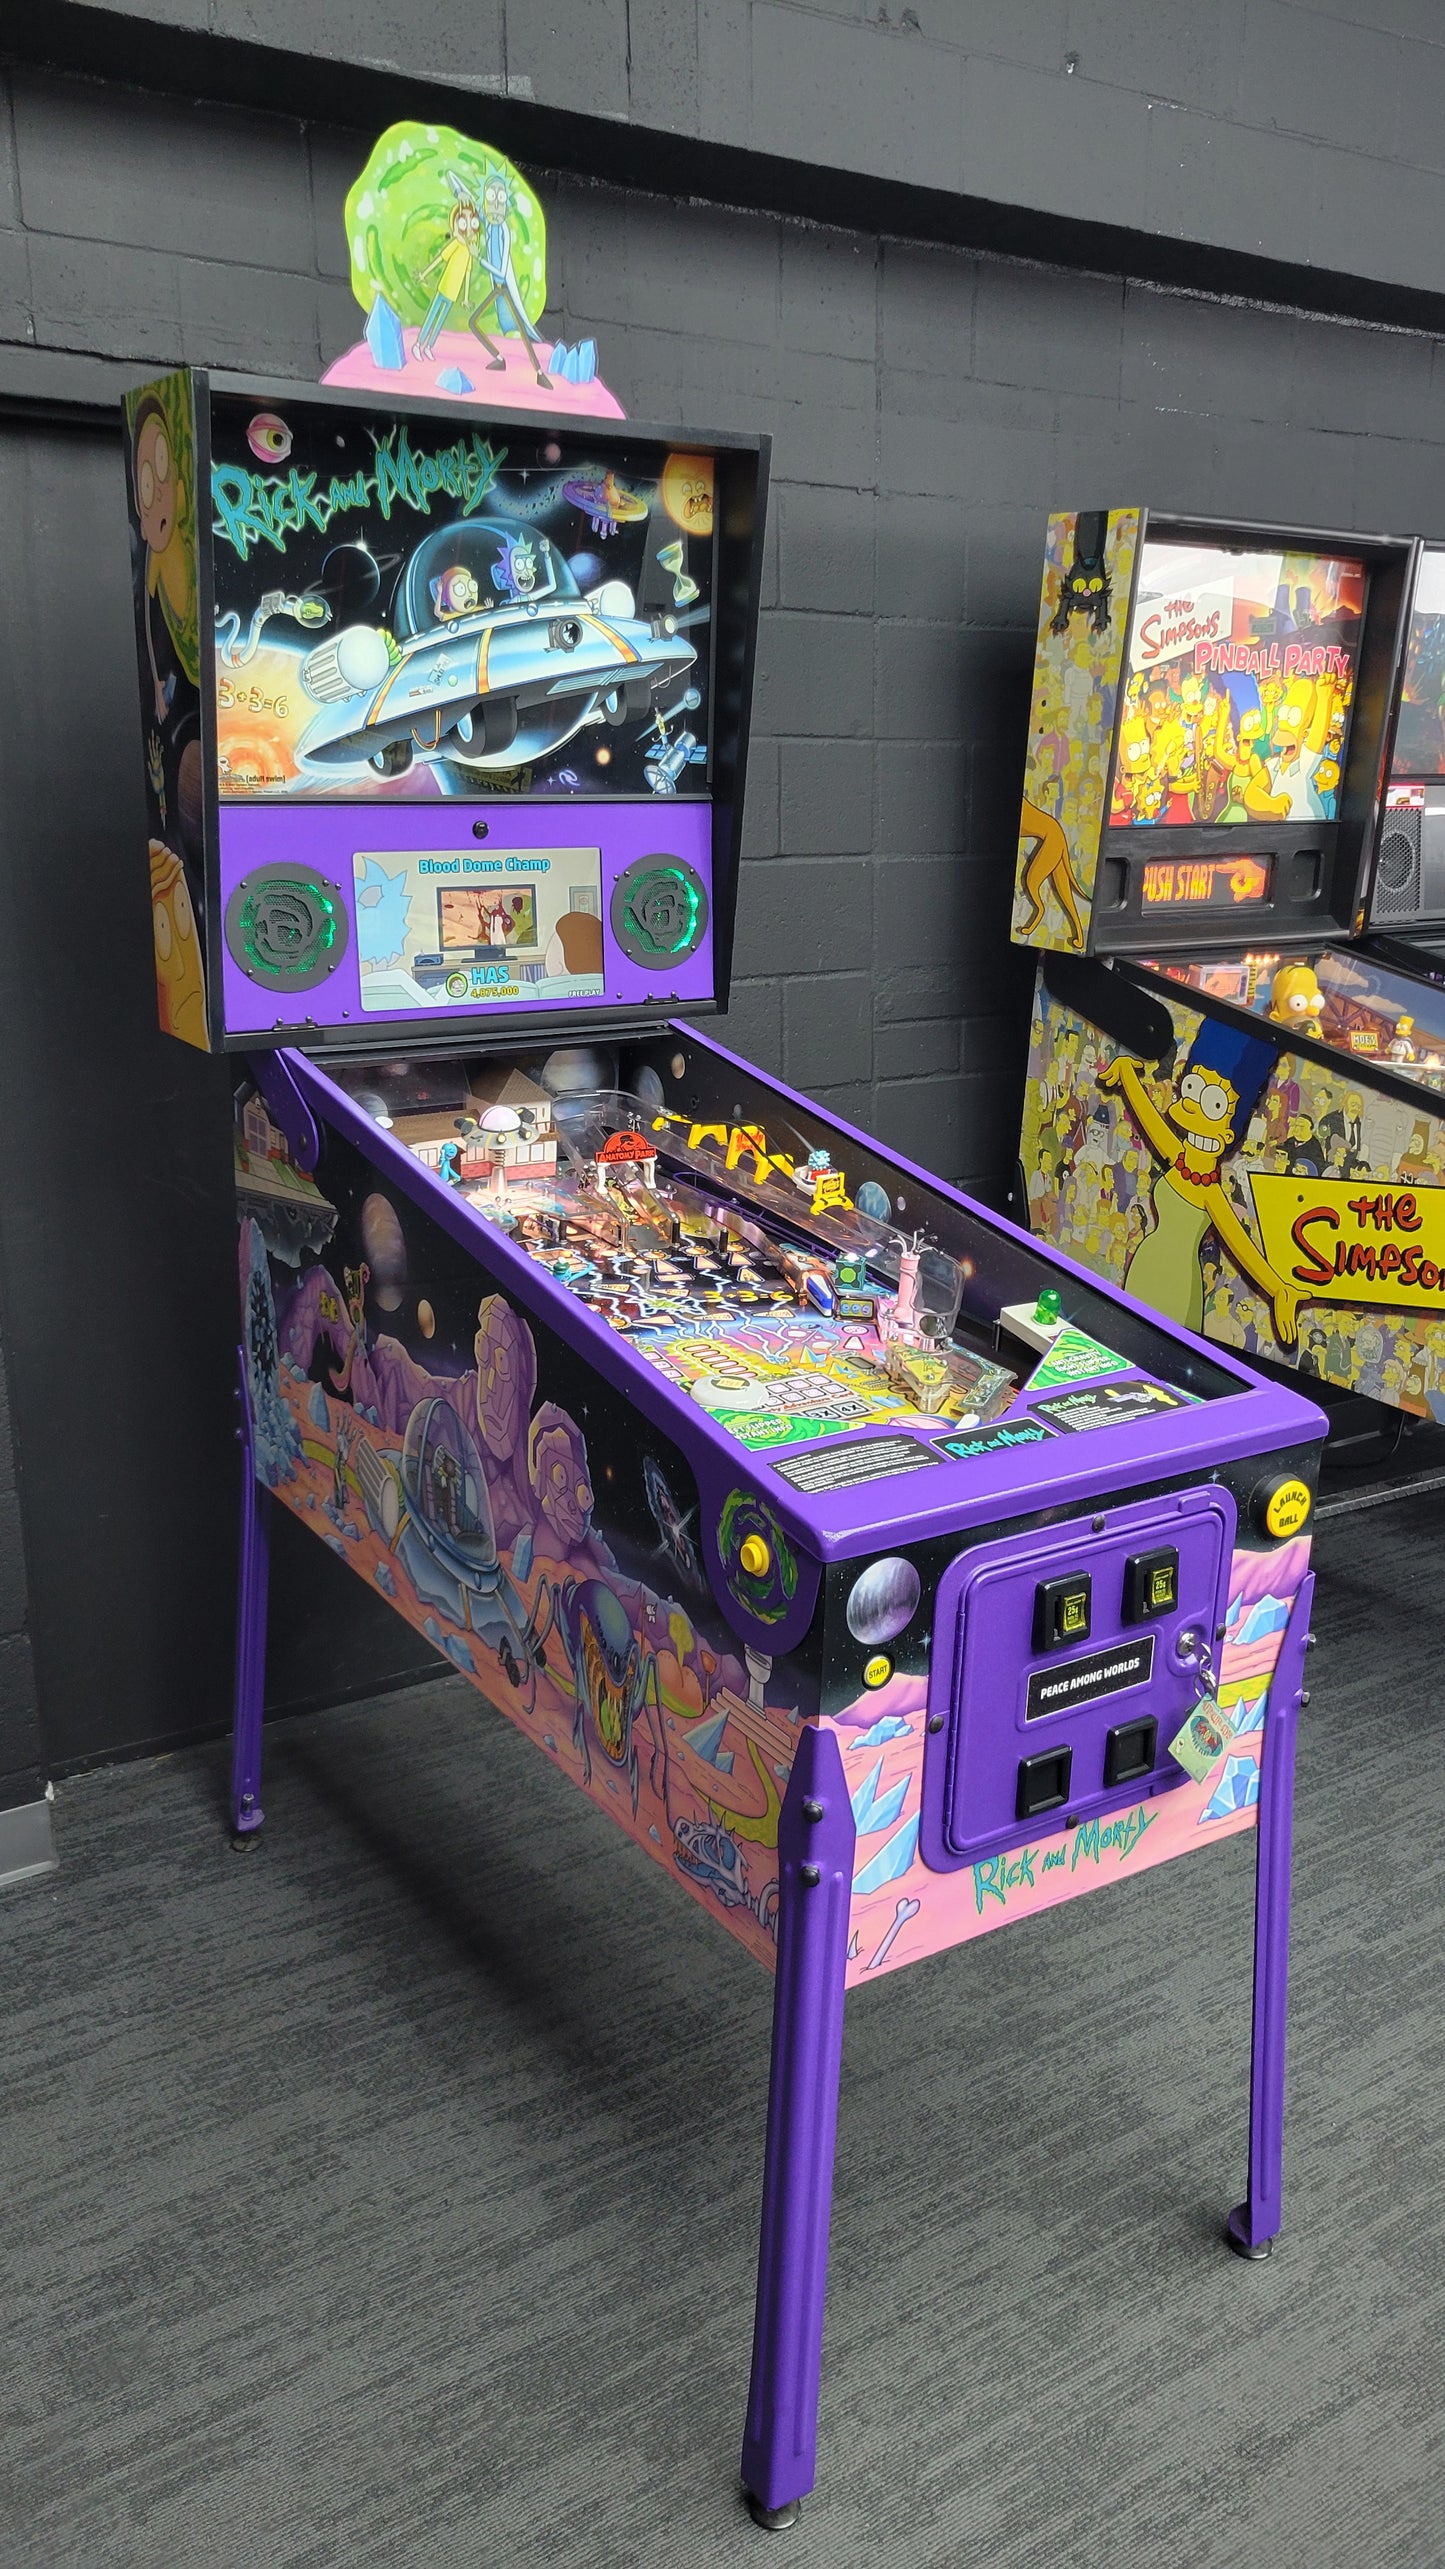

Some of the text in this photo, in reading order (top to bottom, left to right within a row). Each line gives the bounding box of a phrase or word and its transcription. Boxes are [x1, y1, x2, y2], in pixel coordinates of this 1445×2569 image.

[1194, 641, 1350, 680] PINBALL PARTY
[419, 857, 550, 874] Blood Dome Champ
[1175, 864, 1216, 901] START
[471, 965, 509, 985] HAS
[471, 986, 519, 999] 4,875,000
[568, 989, 600, 998] FREE PLAY
[600, 1150, 655, 1162] ANATOMY PARK
[772, 1424, 793, 1433] INFO
[1274, 1491, 1307, 1513] LAUNCH
[1279, 1514, 1298, 1528] BALL
[868, 1665, 887, 1679] START
[1040, 1657, 1140, 1700] PEACE AMONG WORLDS
